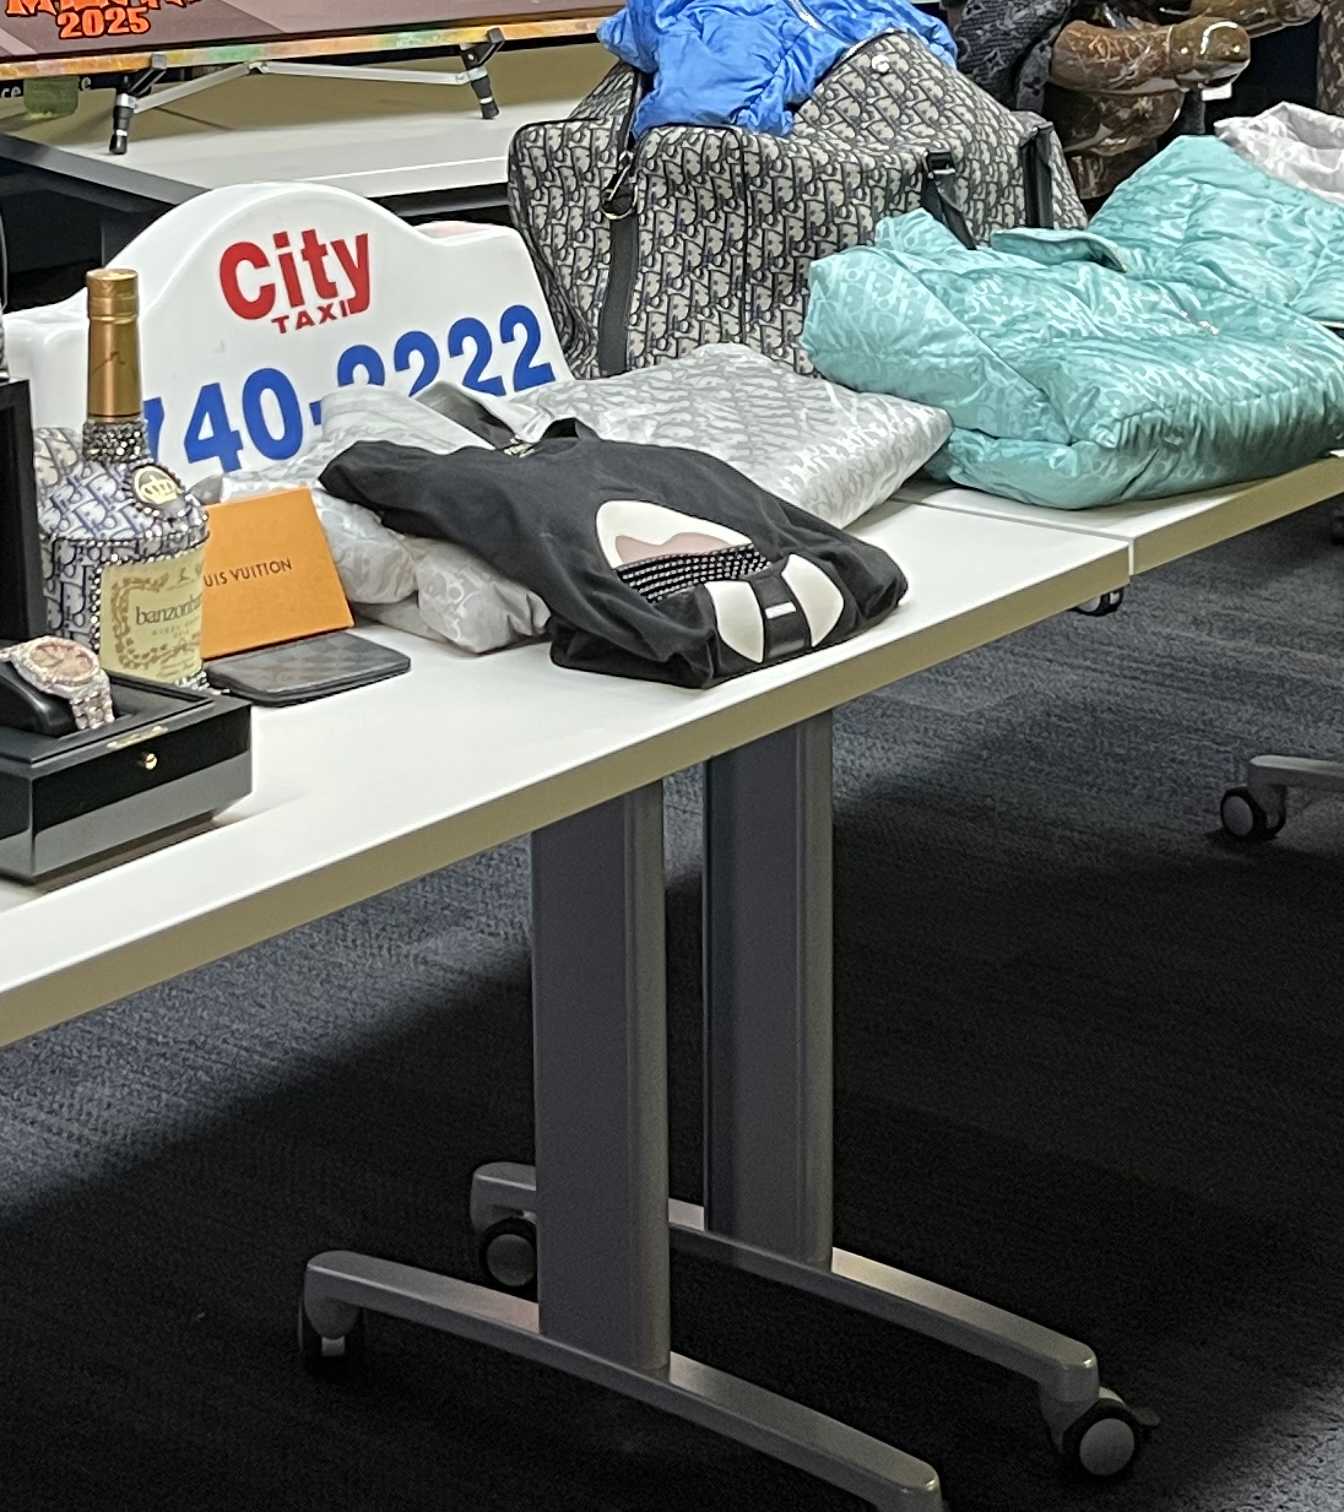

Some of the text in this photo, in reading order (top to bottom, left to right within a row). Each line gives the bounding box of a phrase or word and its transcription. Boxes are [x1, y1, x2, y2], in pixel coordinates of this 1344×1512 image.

[56, 5, 151, 40] 2025
[219, 228, 370, 321] City
[271, 299, 353, 335] TAXI
[203, 572, 228, 587] UIS
[229, 557, 293, 582] VUITTON
